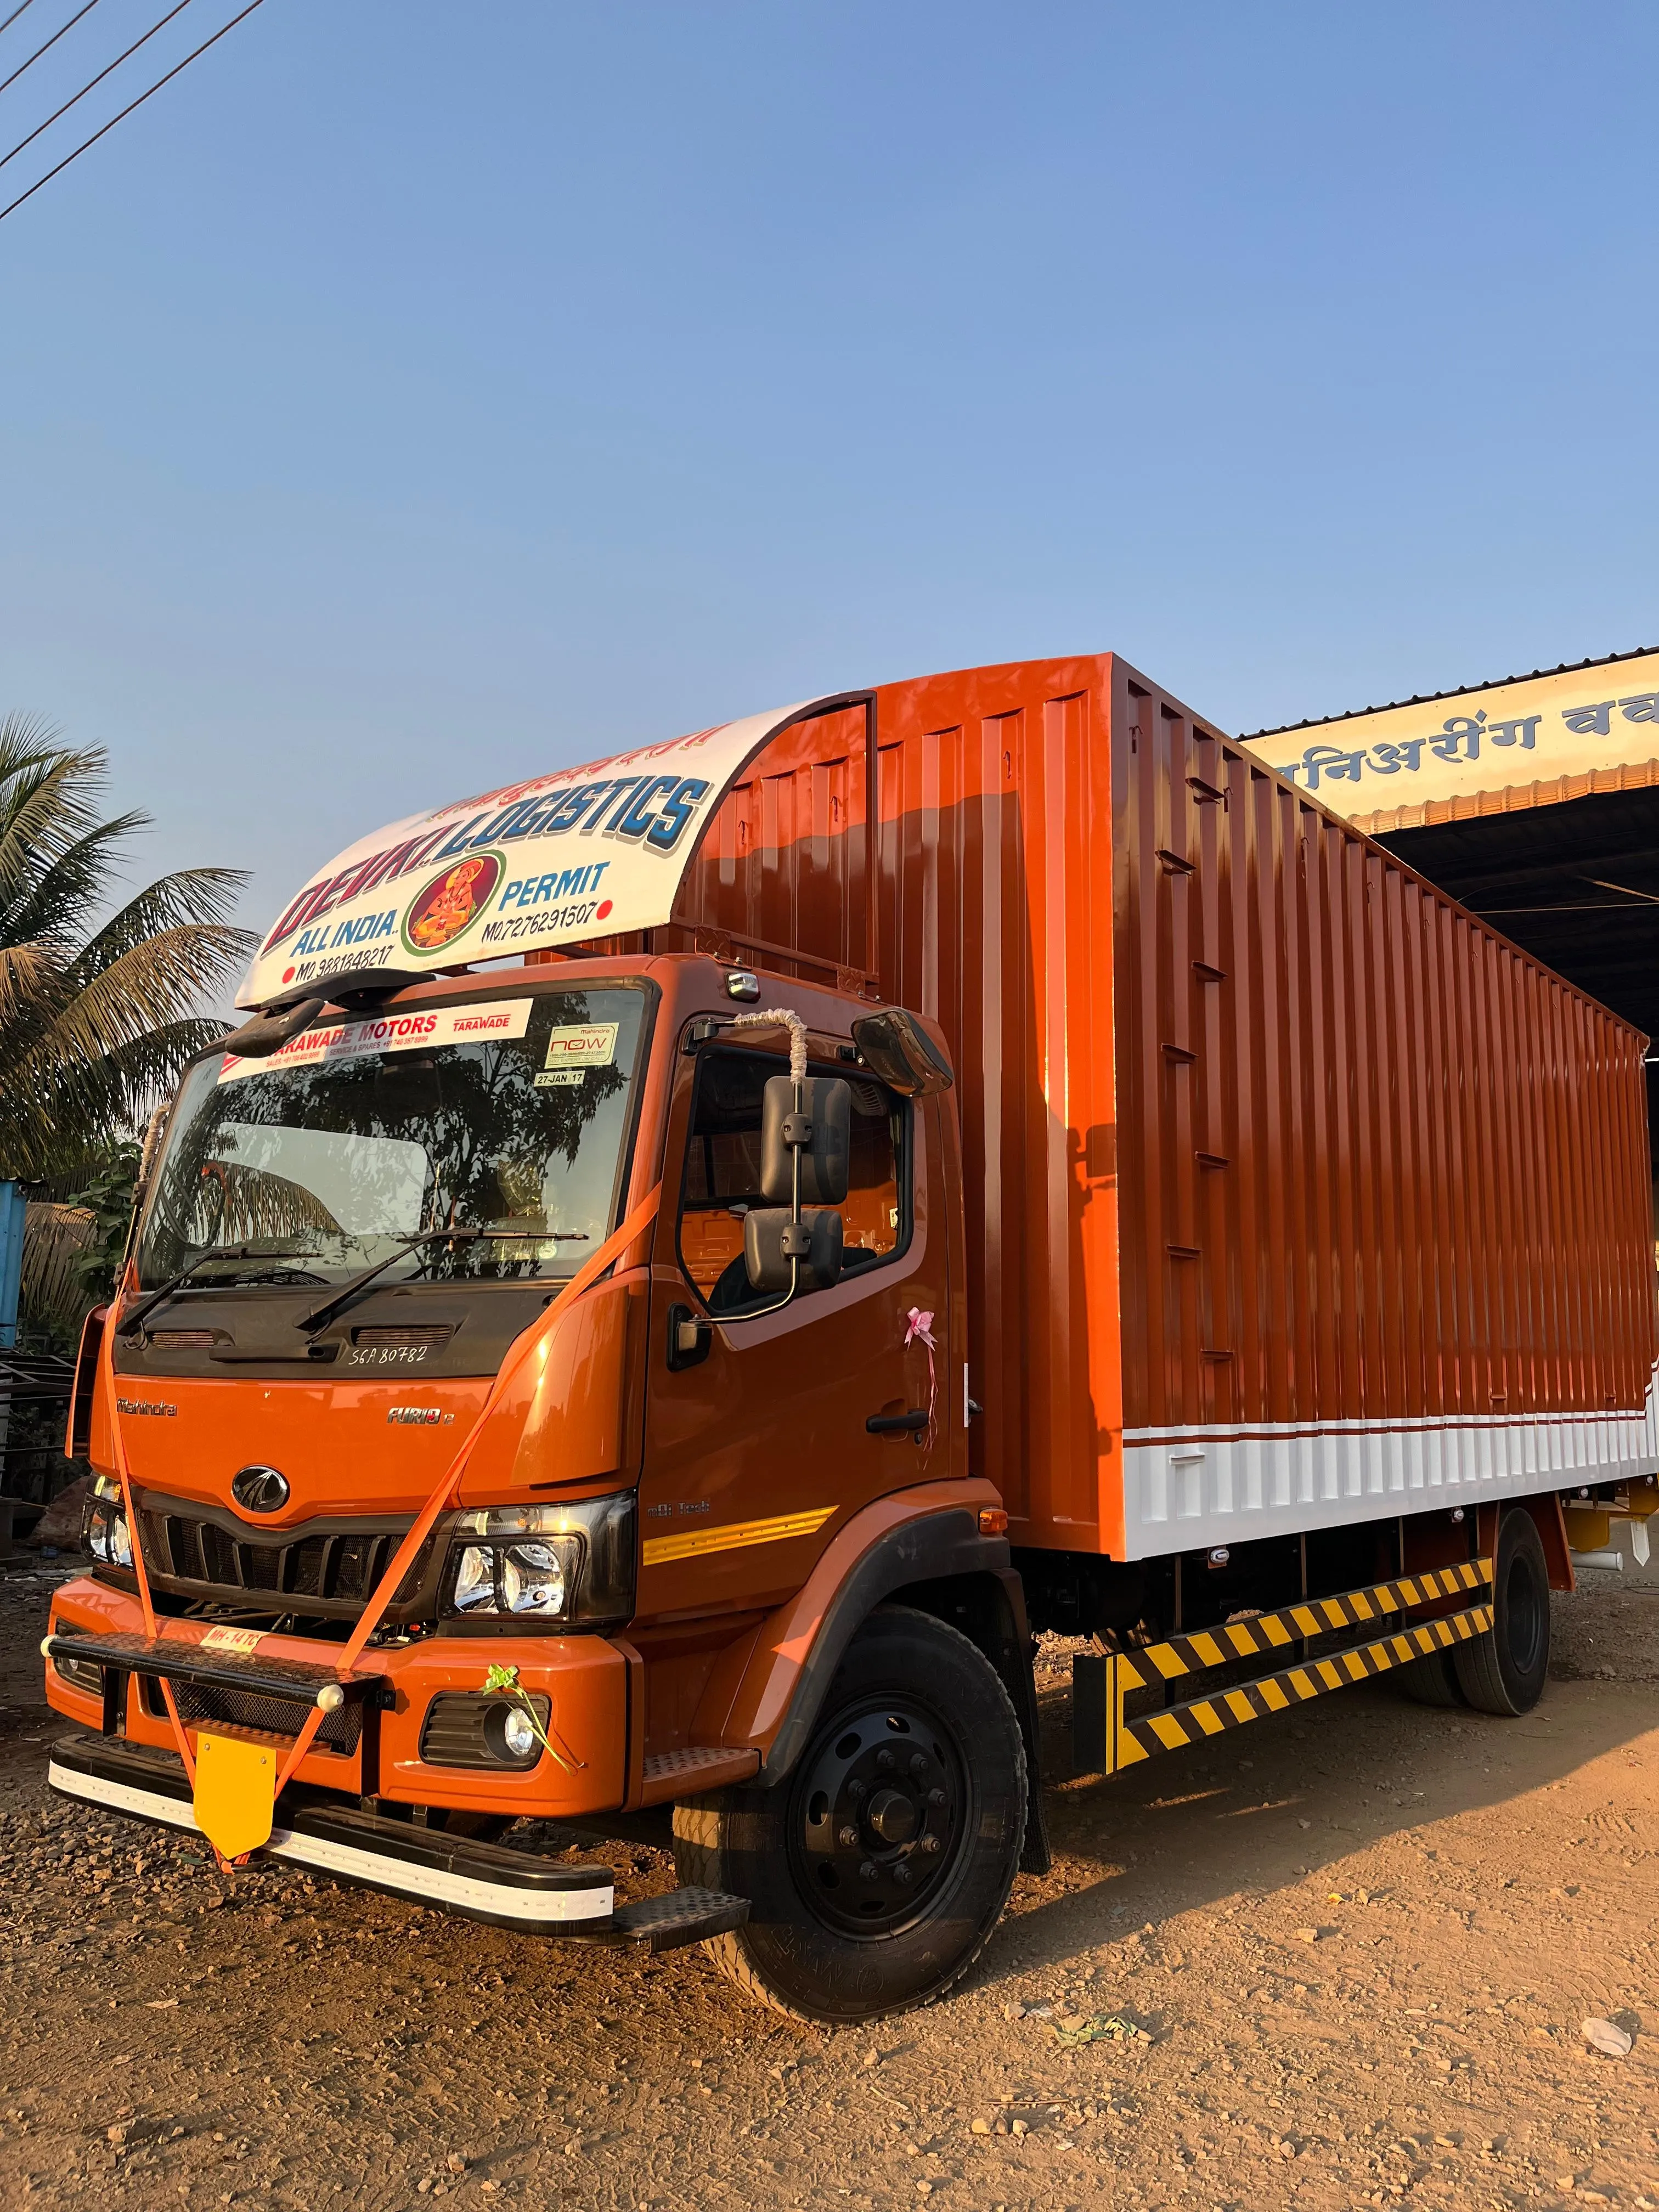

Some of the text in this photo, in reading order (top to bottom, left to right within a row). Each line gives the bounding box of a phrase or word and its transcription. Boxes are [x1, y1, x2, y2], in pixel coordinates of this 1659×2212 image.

[1273, 709, 1542, 790] निअरींग
[432, 776, 711, 861] LOGISTICS
[498, 861, 611, 911] PERMIT
[289, 926, 331, 958] ALL
[317, 944, 395, 978] 9881848217
[453, 1014, 511, 1032] TARAWADE
[274, 1015, 438, 1057] RAWADE MOTORS
[329, 1047, 352, 1056] SERVICE
[358, 1041, 380, 1051] SPARES
[537, 1074, 567, 1084] 27-JAN
[387, 1407, 441, 1425] FURIO
[678, 1500, 710, 1514] Tech
[208, 1629, 228, 1641] MH
